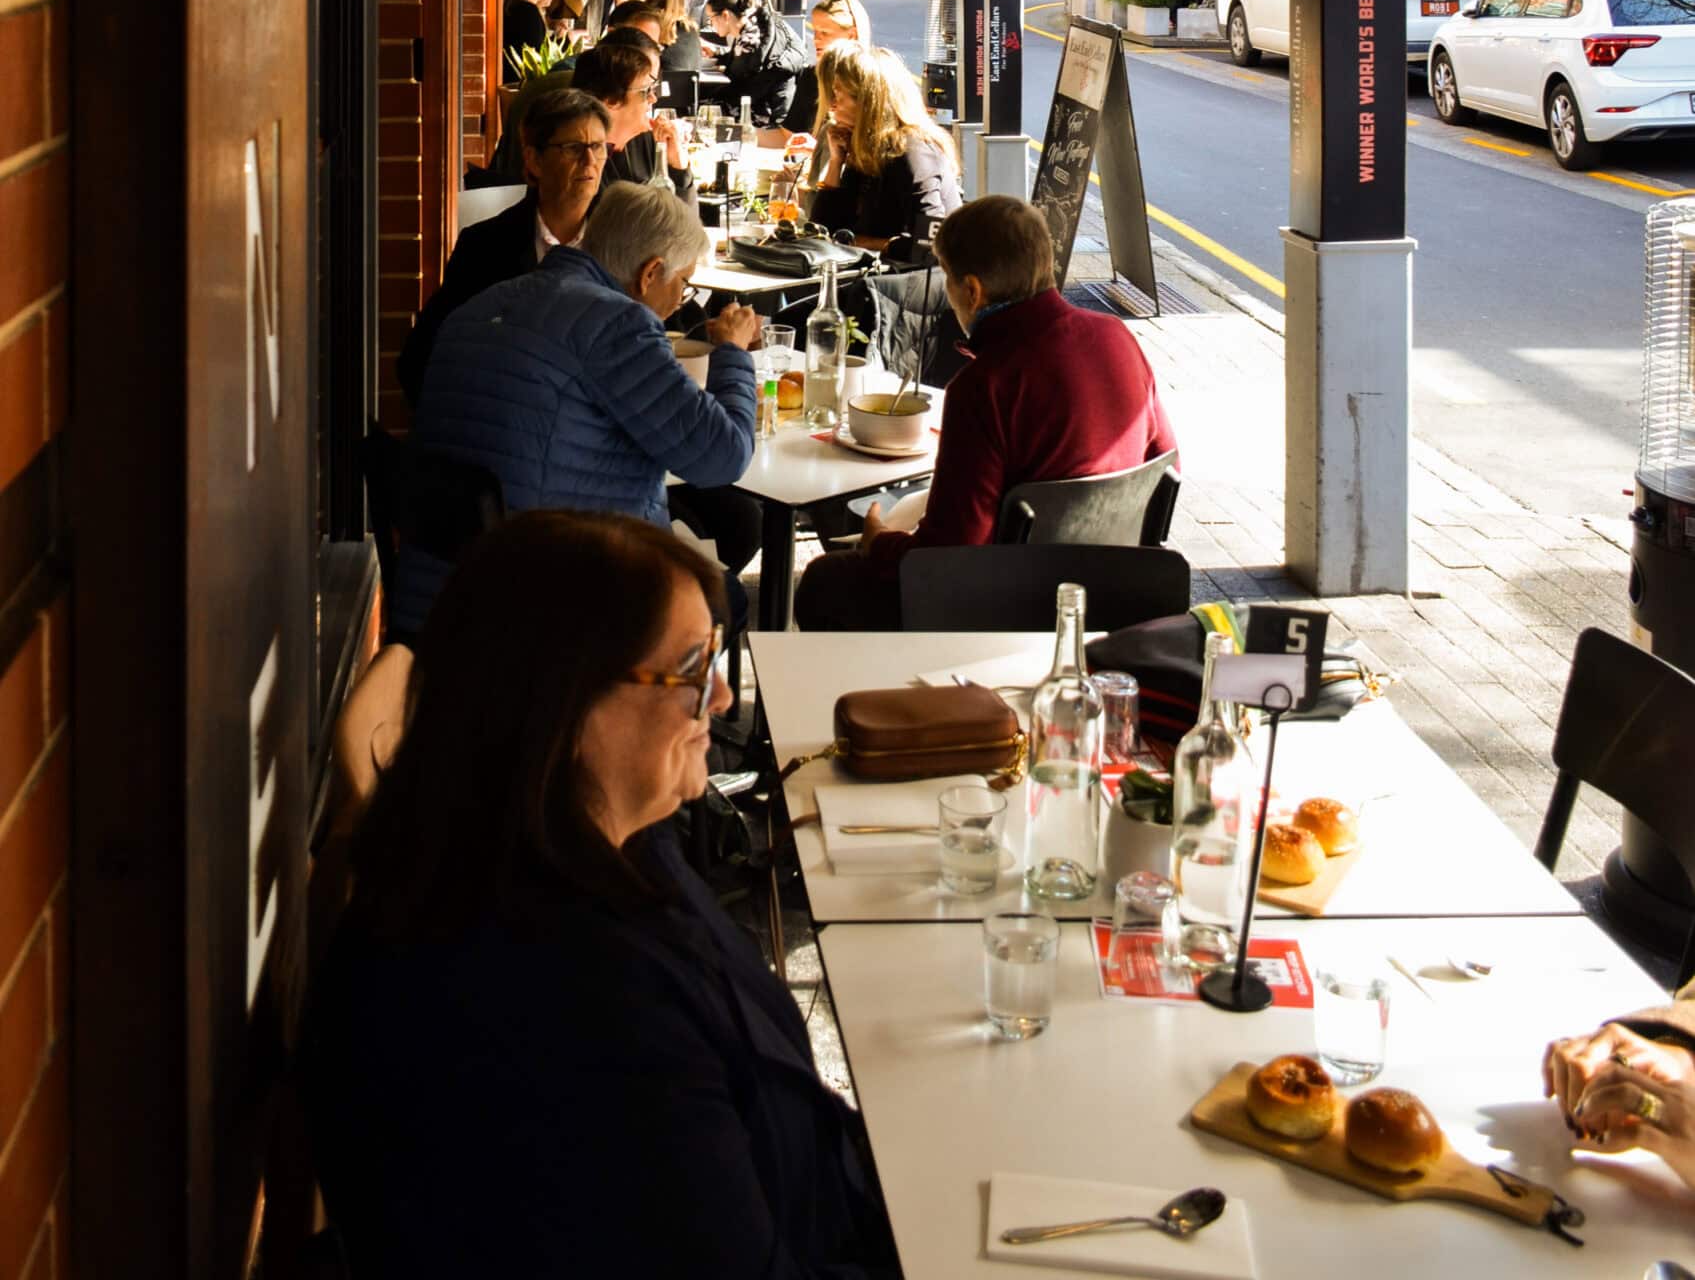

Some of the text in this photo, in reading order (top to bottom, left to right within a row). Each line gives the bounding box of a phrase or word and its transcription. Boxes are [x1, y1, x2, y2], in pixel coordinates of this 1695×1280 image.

[990, 6, 1000, 83] East End Cellars
[1358, 25, 1376, 105] WORLD'S
[725, 128, 733, 141] 7
[1358, 112, 1376, 183] WINNER
[1285, 618, 1309, 653] 5
